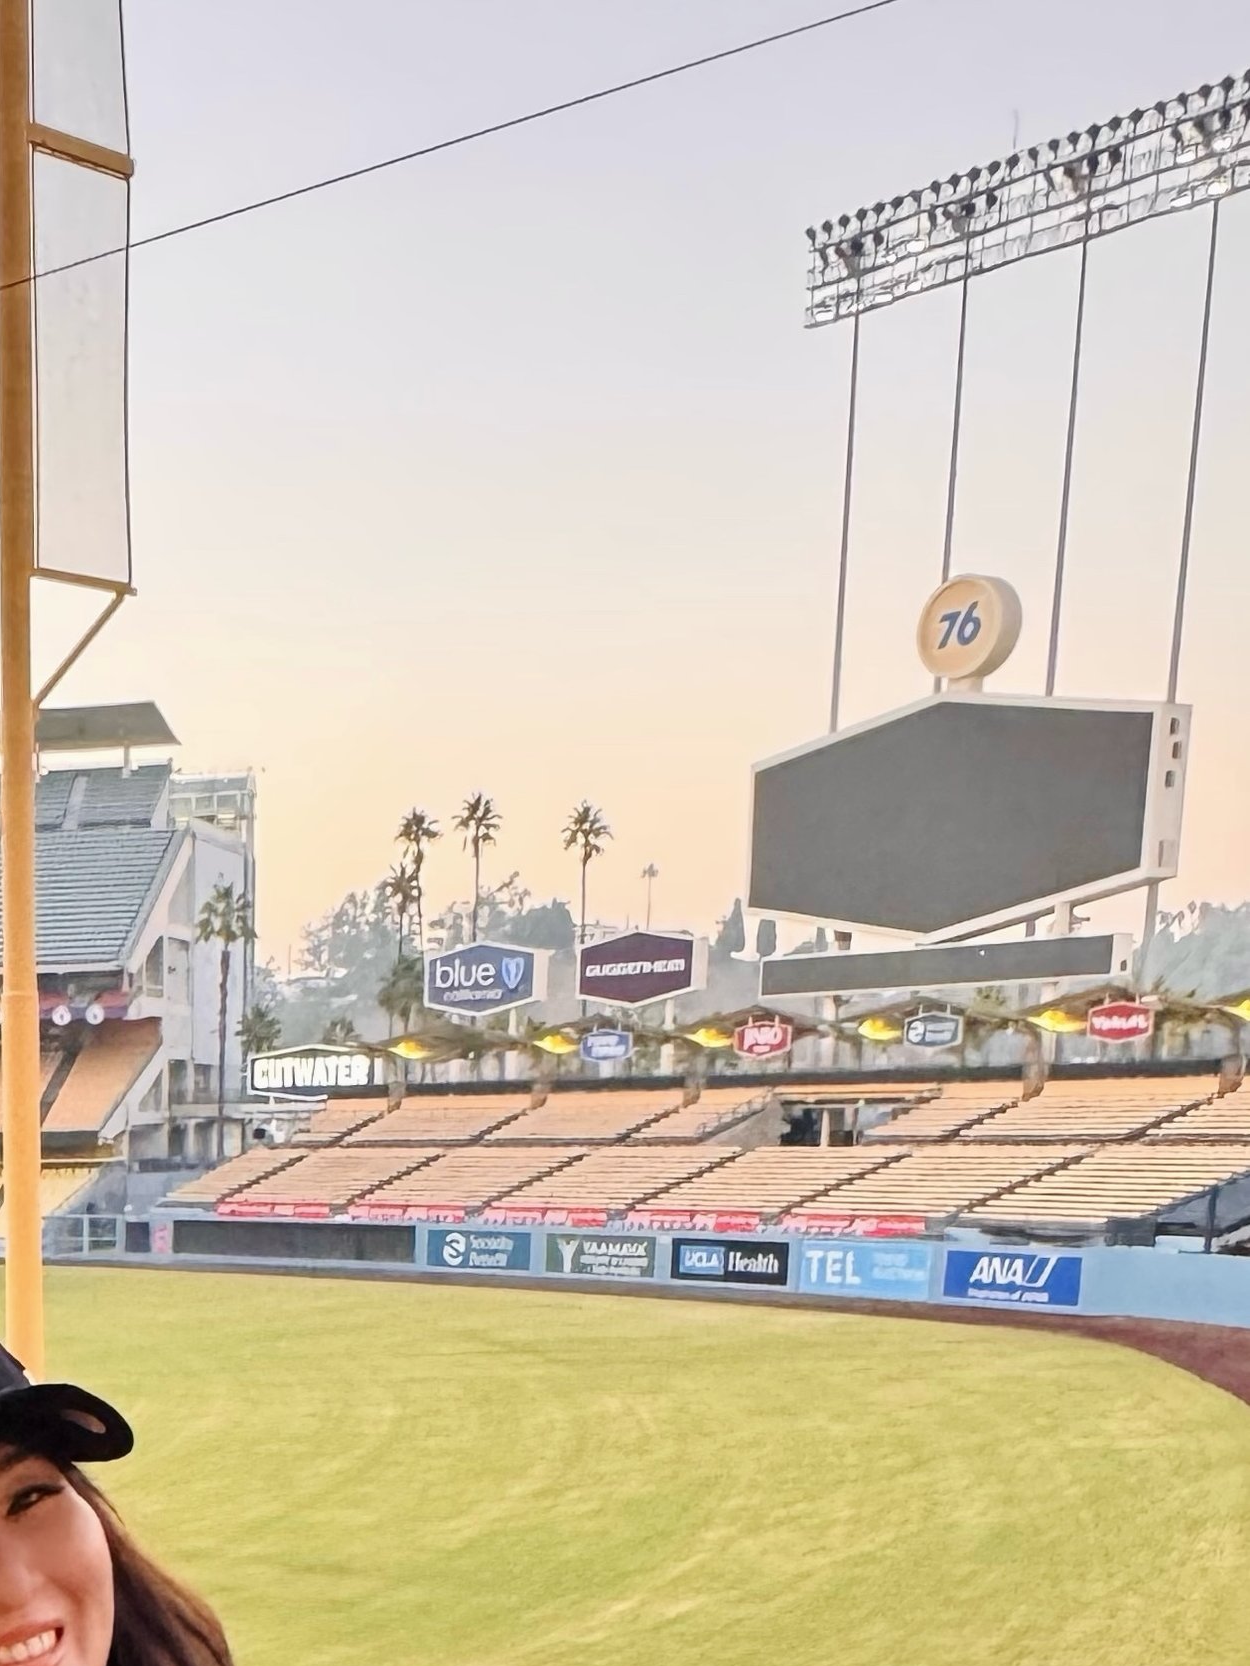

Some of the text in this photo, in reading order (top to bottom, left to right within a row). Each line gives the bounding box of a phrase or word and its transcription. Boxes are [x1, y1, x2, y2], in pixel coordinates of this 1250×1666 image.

[936, 600, 982, 650] 76
[435, 958, 496, 989] blue
[253, 1054, 370, 1090] CUTWATER
[684, 1251, 780, 1275] UCLA Health
[805, 1250, 862, 1286] TEL
[969, 1256, 1025, 1286] ANA
